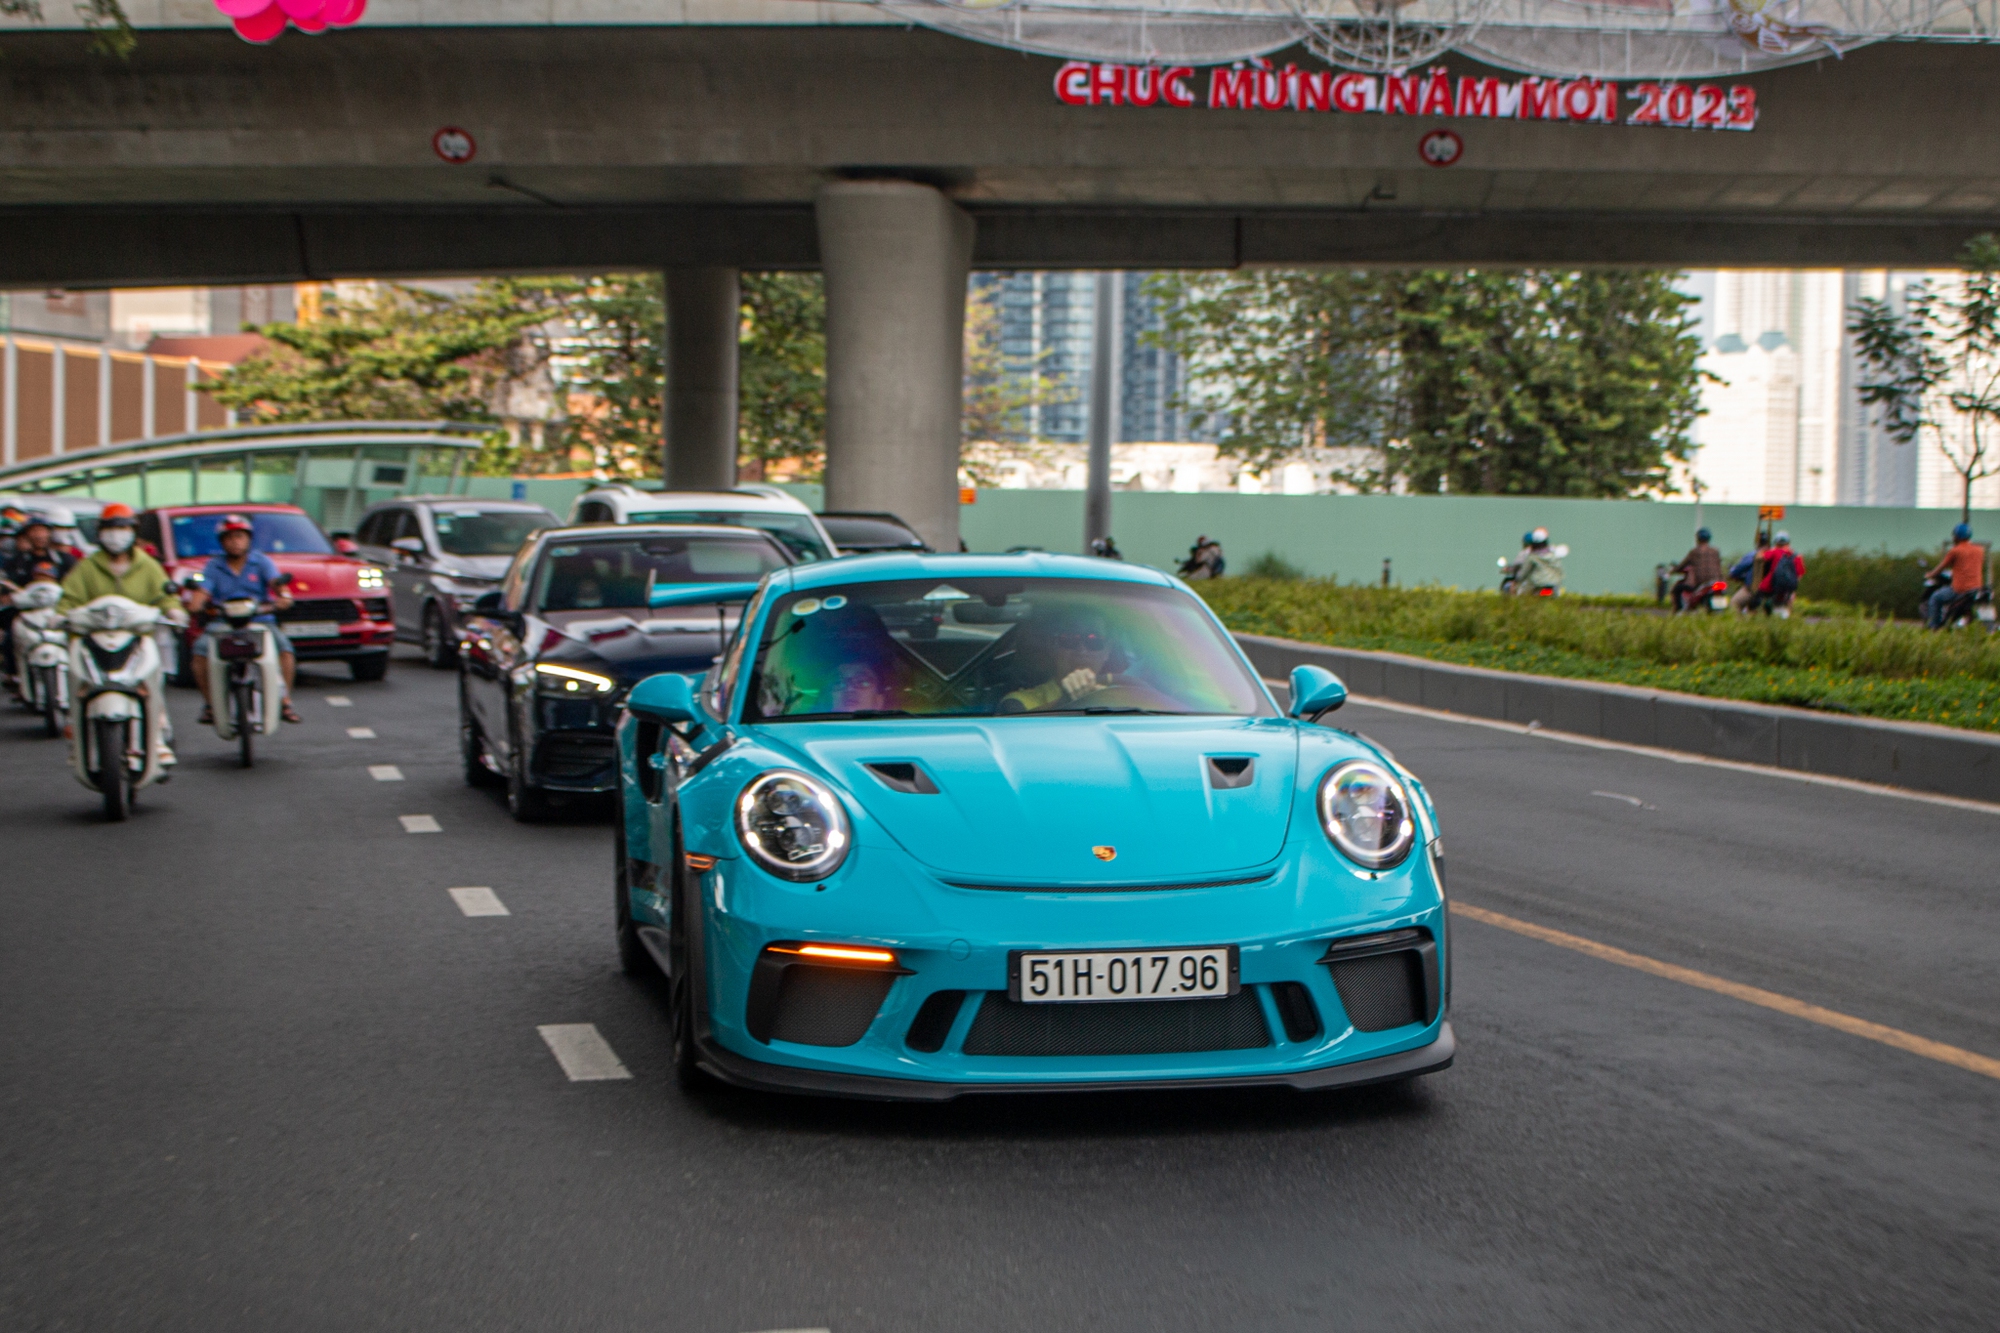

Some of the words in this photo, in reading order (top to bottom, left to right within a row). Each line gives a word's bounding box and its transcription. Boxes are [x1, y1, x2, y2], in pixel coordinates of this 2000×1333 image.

[1384, 66, 1499, 117] NĂM
[1626, 82, 1757, 130] 2023
[1029, 955, 1218, 996] 51H-017.96
